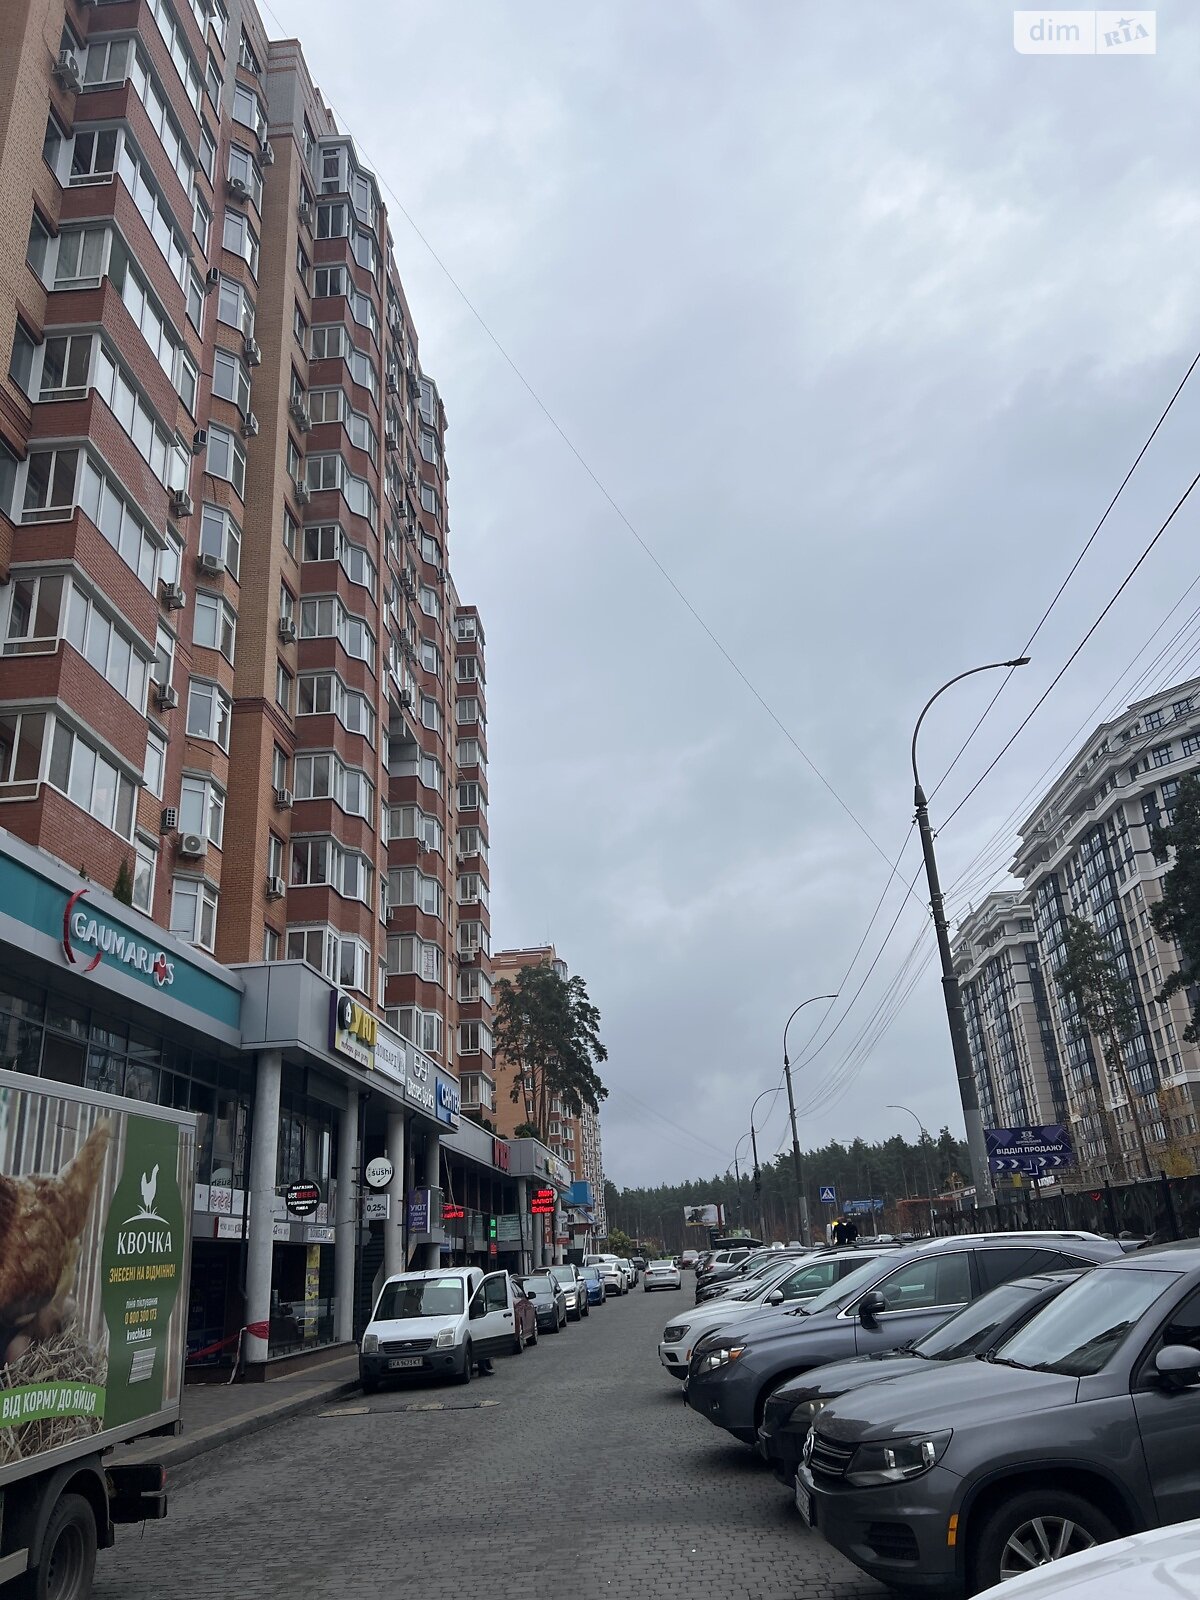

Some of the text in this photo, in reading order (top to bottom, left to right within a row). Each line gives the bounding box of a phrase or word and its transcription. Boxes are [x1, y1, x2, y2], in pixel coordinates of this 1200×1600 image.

[996, 1144, 1063, 1155] ВІДДІЛ ПРОДАЖУ
[371, 1168, 392, 1177] sushi
[410, 1204, 427, 1212] УЮТ
[117, 1231, 172, 1255] КВОЧКА
[109, 1264, 176, 1283] ЗНЕСЕНІ НА ВІДМІННО!
[125, 1312, 129, 1325] 0
[126, 1327, 152, 1341] kvochka.ua
[2, 1386, 97, 1419] ВІД КОРМУ ДО ЯЙЦЯ
